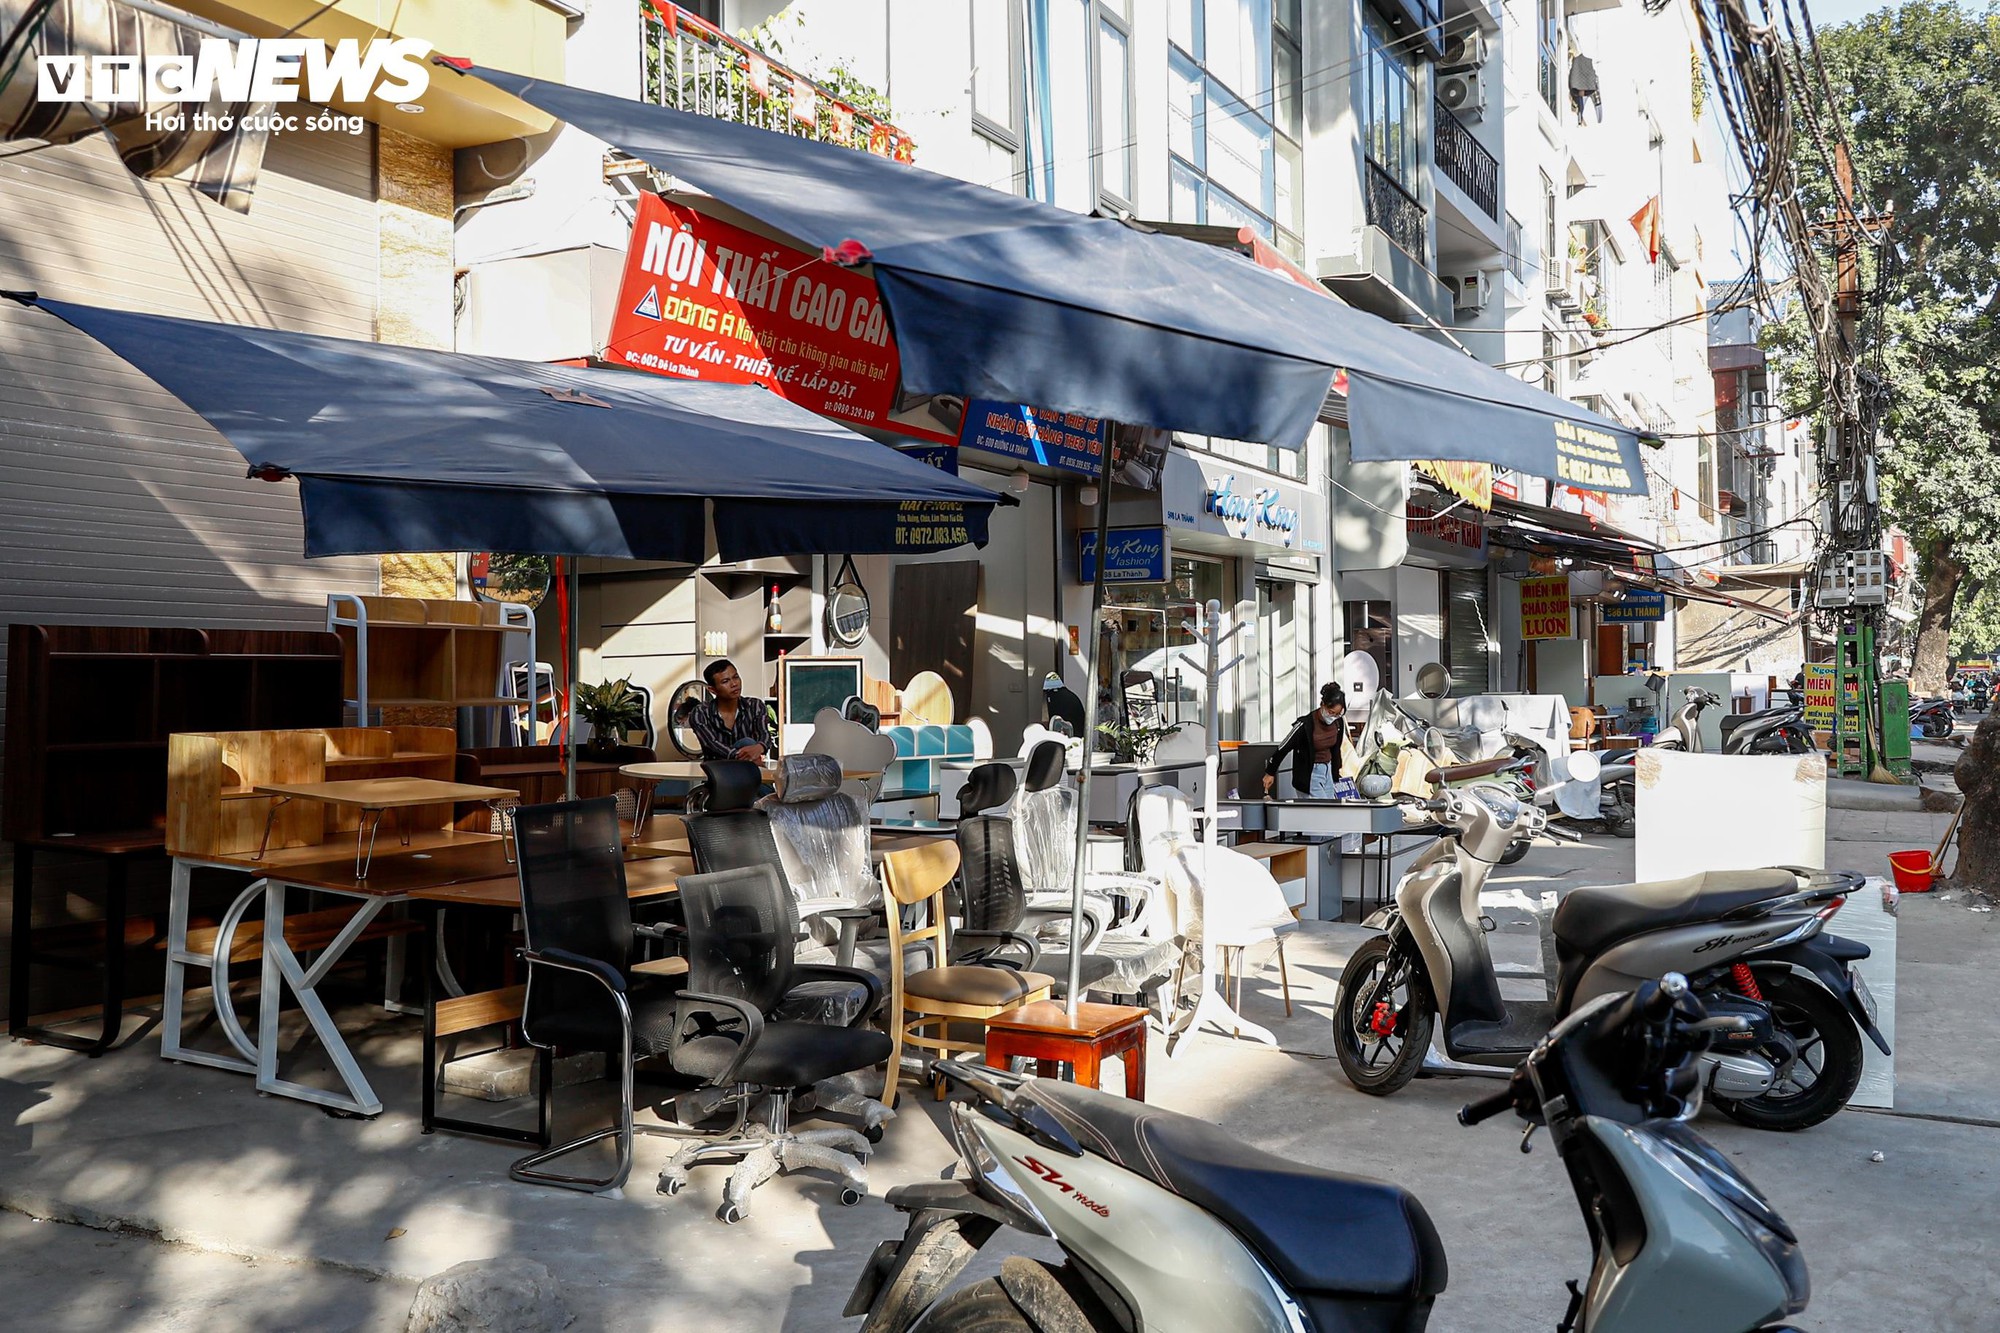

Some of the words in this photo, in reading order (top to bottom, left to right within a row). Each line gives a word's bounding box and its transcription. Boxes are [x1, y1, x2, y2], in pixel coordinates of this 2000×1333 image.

[641, 221, 707, 292] NỘI
[711, 245, 789, 313] THẤT
[789, 276, 847, 332] CAO
[663, 296, 719, 332] ĐÔNG
[719, 310, 736, 337] Á
[779, 337, 797, 355] cho
[799, 341, 828, 370] không
[828, 350, 849, 372] gian
[850, 358, 867, 376] nhà
[868, 362, 889, 382] bạn!
[625, 350, 641, 363] ĐC:
[640, 352, 659, 368] 602
[663, 334, 689, 354] TƯ
[689, 340, 726, 365] VẤN
[733, 354, 775, 377] THIẾT
[774, 364, 800, 383] KẾ
[800, 370, 828, 391] LẮP
[828, 381, 857, 400] ĐẶT
[985, 412, 1016, 435] NHẬN
[1063, 433, 1086, 452] THEO
[910, 526, 968, 545] 0972.083.456
[1082, 541, 1120, 560] Hng
[1121, 538, 1161, 558] Kong
[1116, 557, 1151, 566] fashion
[1122, 569, 1143, 578] Thành
[1623, 607, 1633, 617] LA
[1635, 605, 1660, 617] THÀNH
[1525, 618, 1567, 636] LƯƠN
[1807, 675, 1831, 690] MIẾN
[1072, 1191, 1110, 1217] mode
